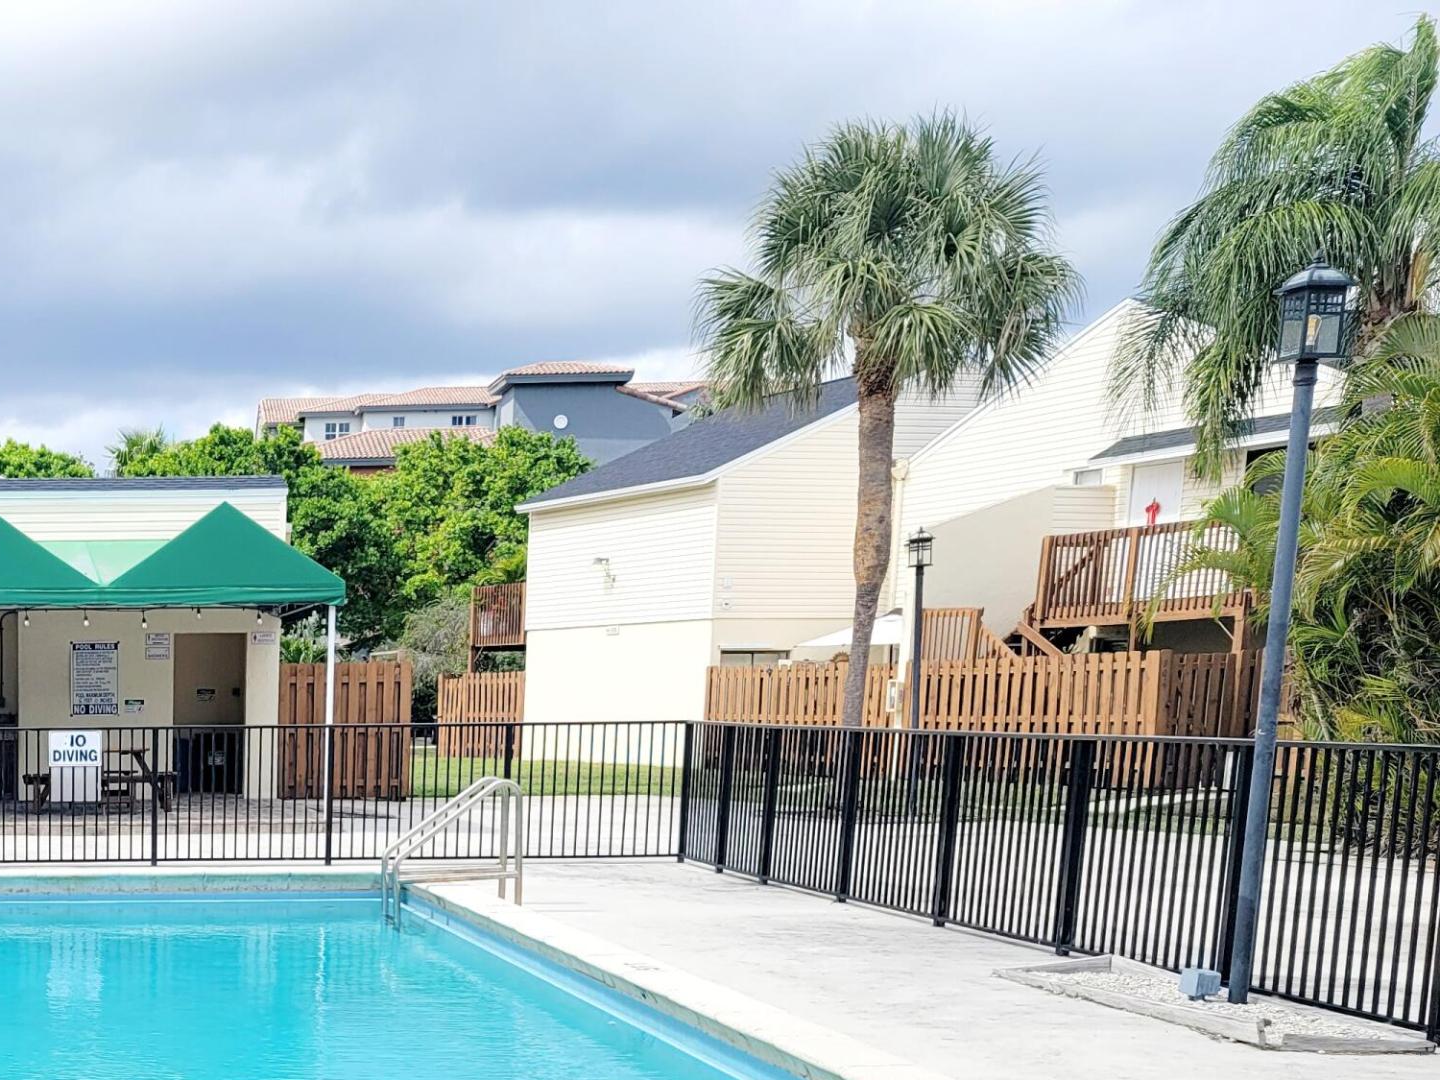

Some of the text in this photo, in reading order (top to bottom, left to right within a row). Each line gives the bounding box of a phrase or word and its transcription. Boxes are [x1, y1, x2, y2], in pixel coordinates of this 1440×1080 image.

[73, 704, 86, 714] NO
[88, 704, 118, 714] DIVING
[52, 749, 98, 762] DIVING
